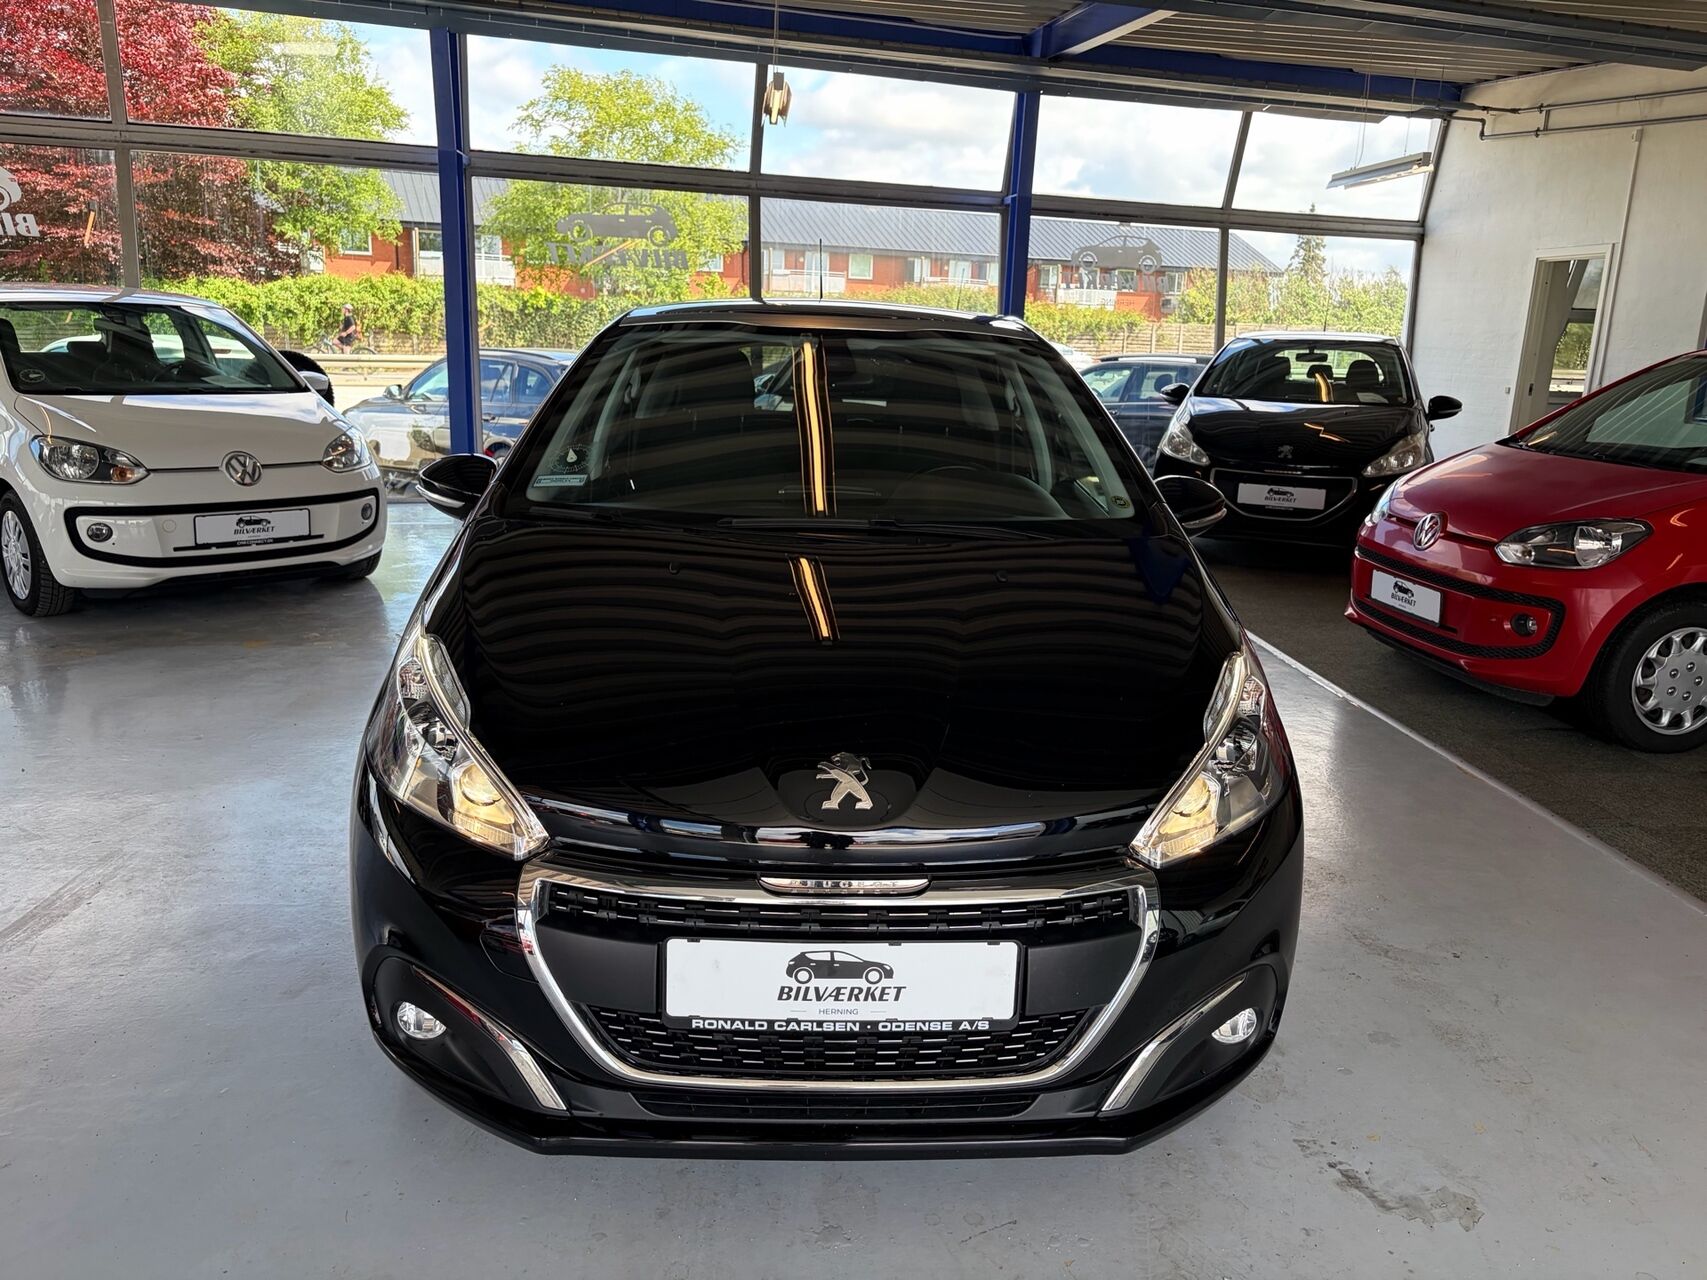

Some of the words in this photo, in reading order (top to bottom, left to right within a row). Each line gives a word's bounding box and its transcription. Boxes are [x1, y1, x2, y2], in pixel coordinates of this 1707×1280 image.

[776, 986, 907, 1002] BILVÆRKET
[818, 1008, 859, 1016] HERNING
[691, 1019, 768, 1031] RONALD
[774, 1021, 860, 1032] CARLSEN
[878, 1021, 953, 1032] ODENSE
[958, 1020, 990, 1031] A/S
